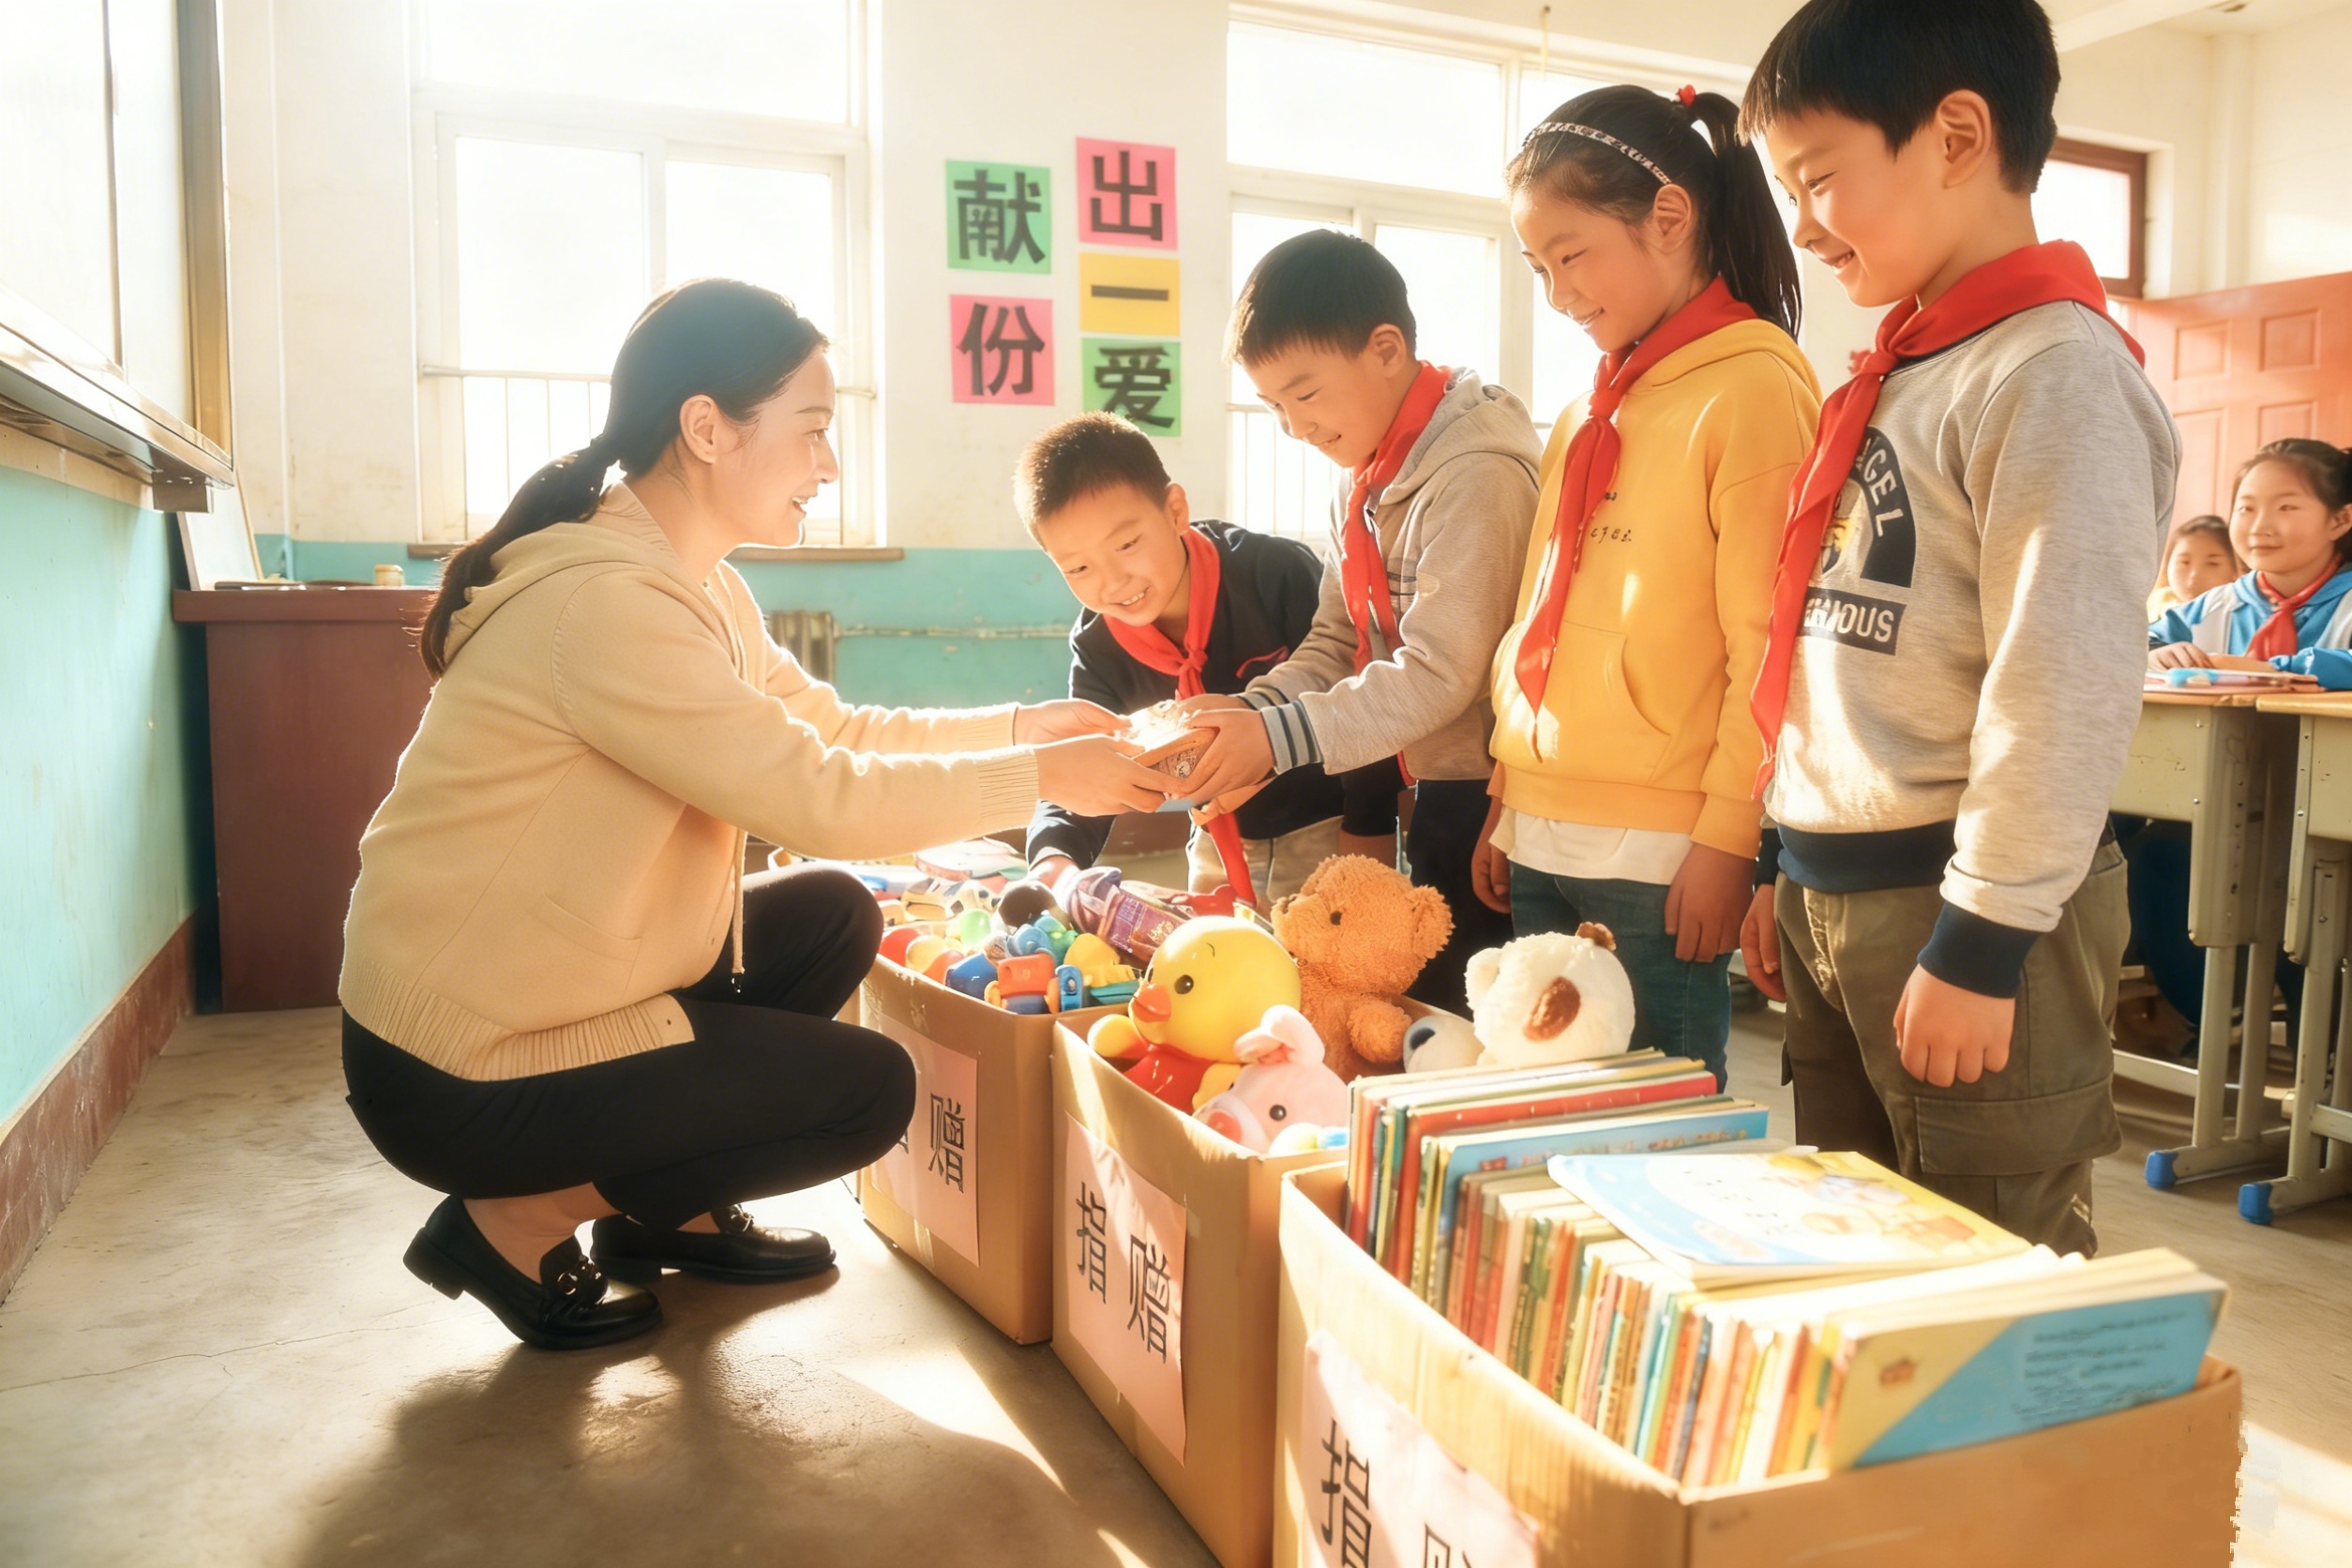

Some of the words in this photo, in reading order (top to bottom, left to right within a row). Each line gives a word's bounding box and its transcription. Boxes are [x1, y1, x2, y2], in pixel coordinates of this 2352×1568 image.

[953, 169, 1046, 264] 献
[1090, 150, 1163, 241] 出
[1091, 284, 1169, 301] 一
[956, 302, 1046, 396] 份
[1093, 346, 1176, 430] 爱
[1076, 1182, 1171, 1364] 捐赠
